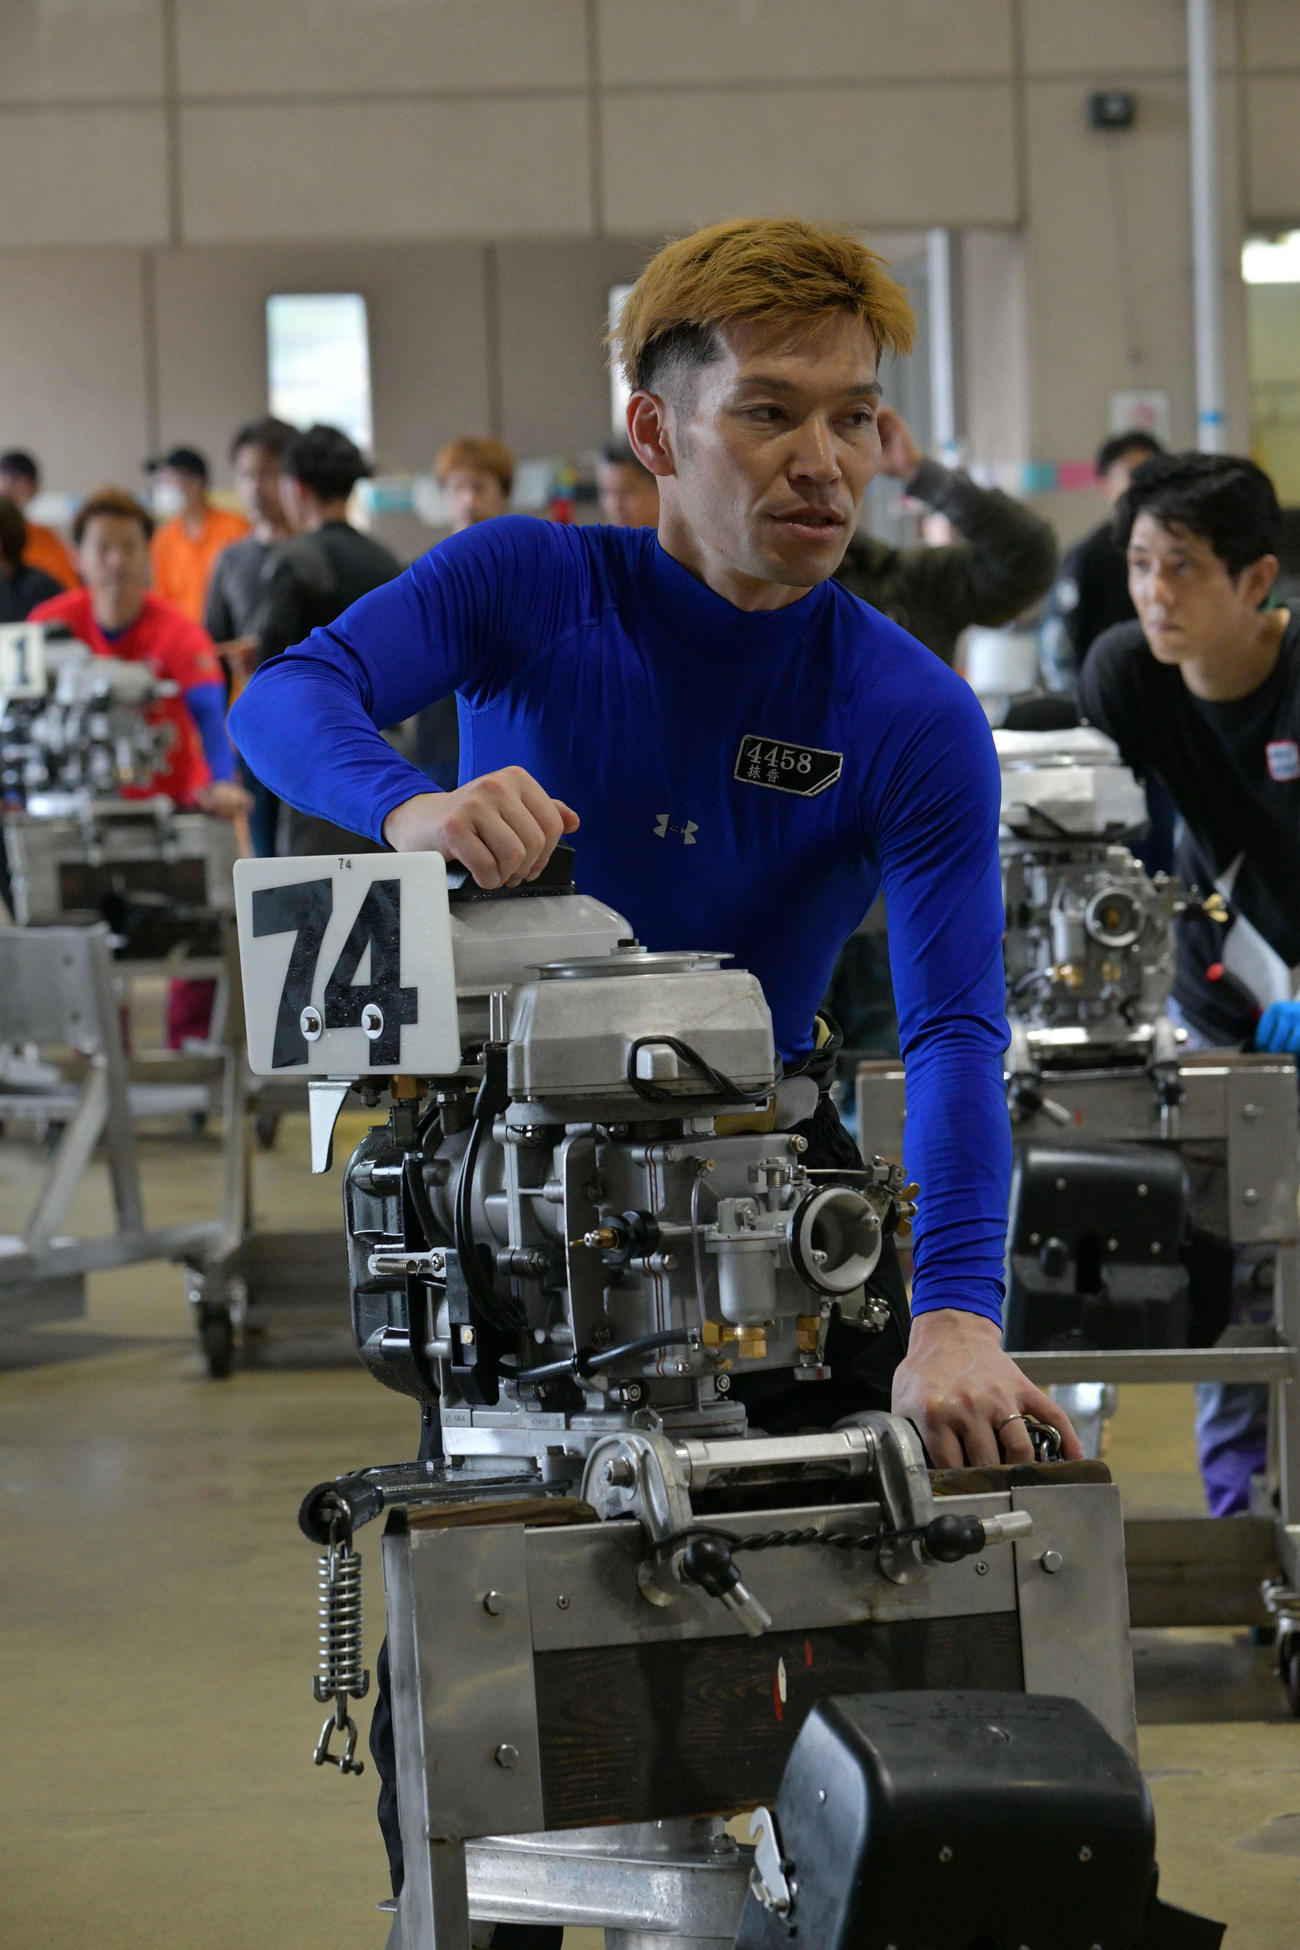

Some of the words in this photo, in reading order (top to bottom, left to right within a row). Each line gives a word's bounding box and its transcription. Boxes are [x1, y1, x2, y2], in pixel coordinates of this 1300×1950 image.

[746, 742, 812, 774] 4458
[338, 856, 352, 870] 74
[252, 877, 418, 1069] 74
